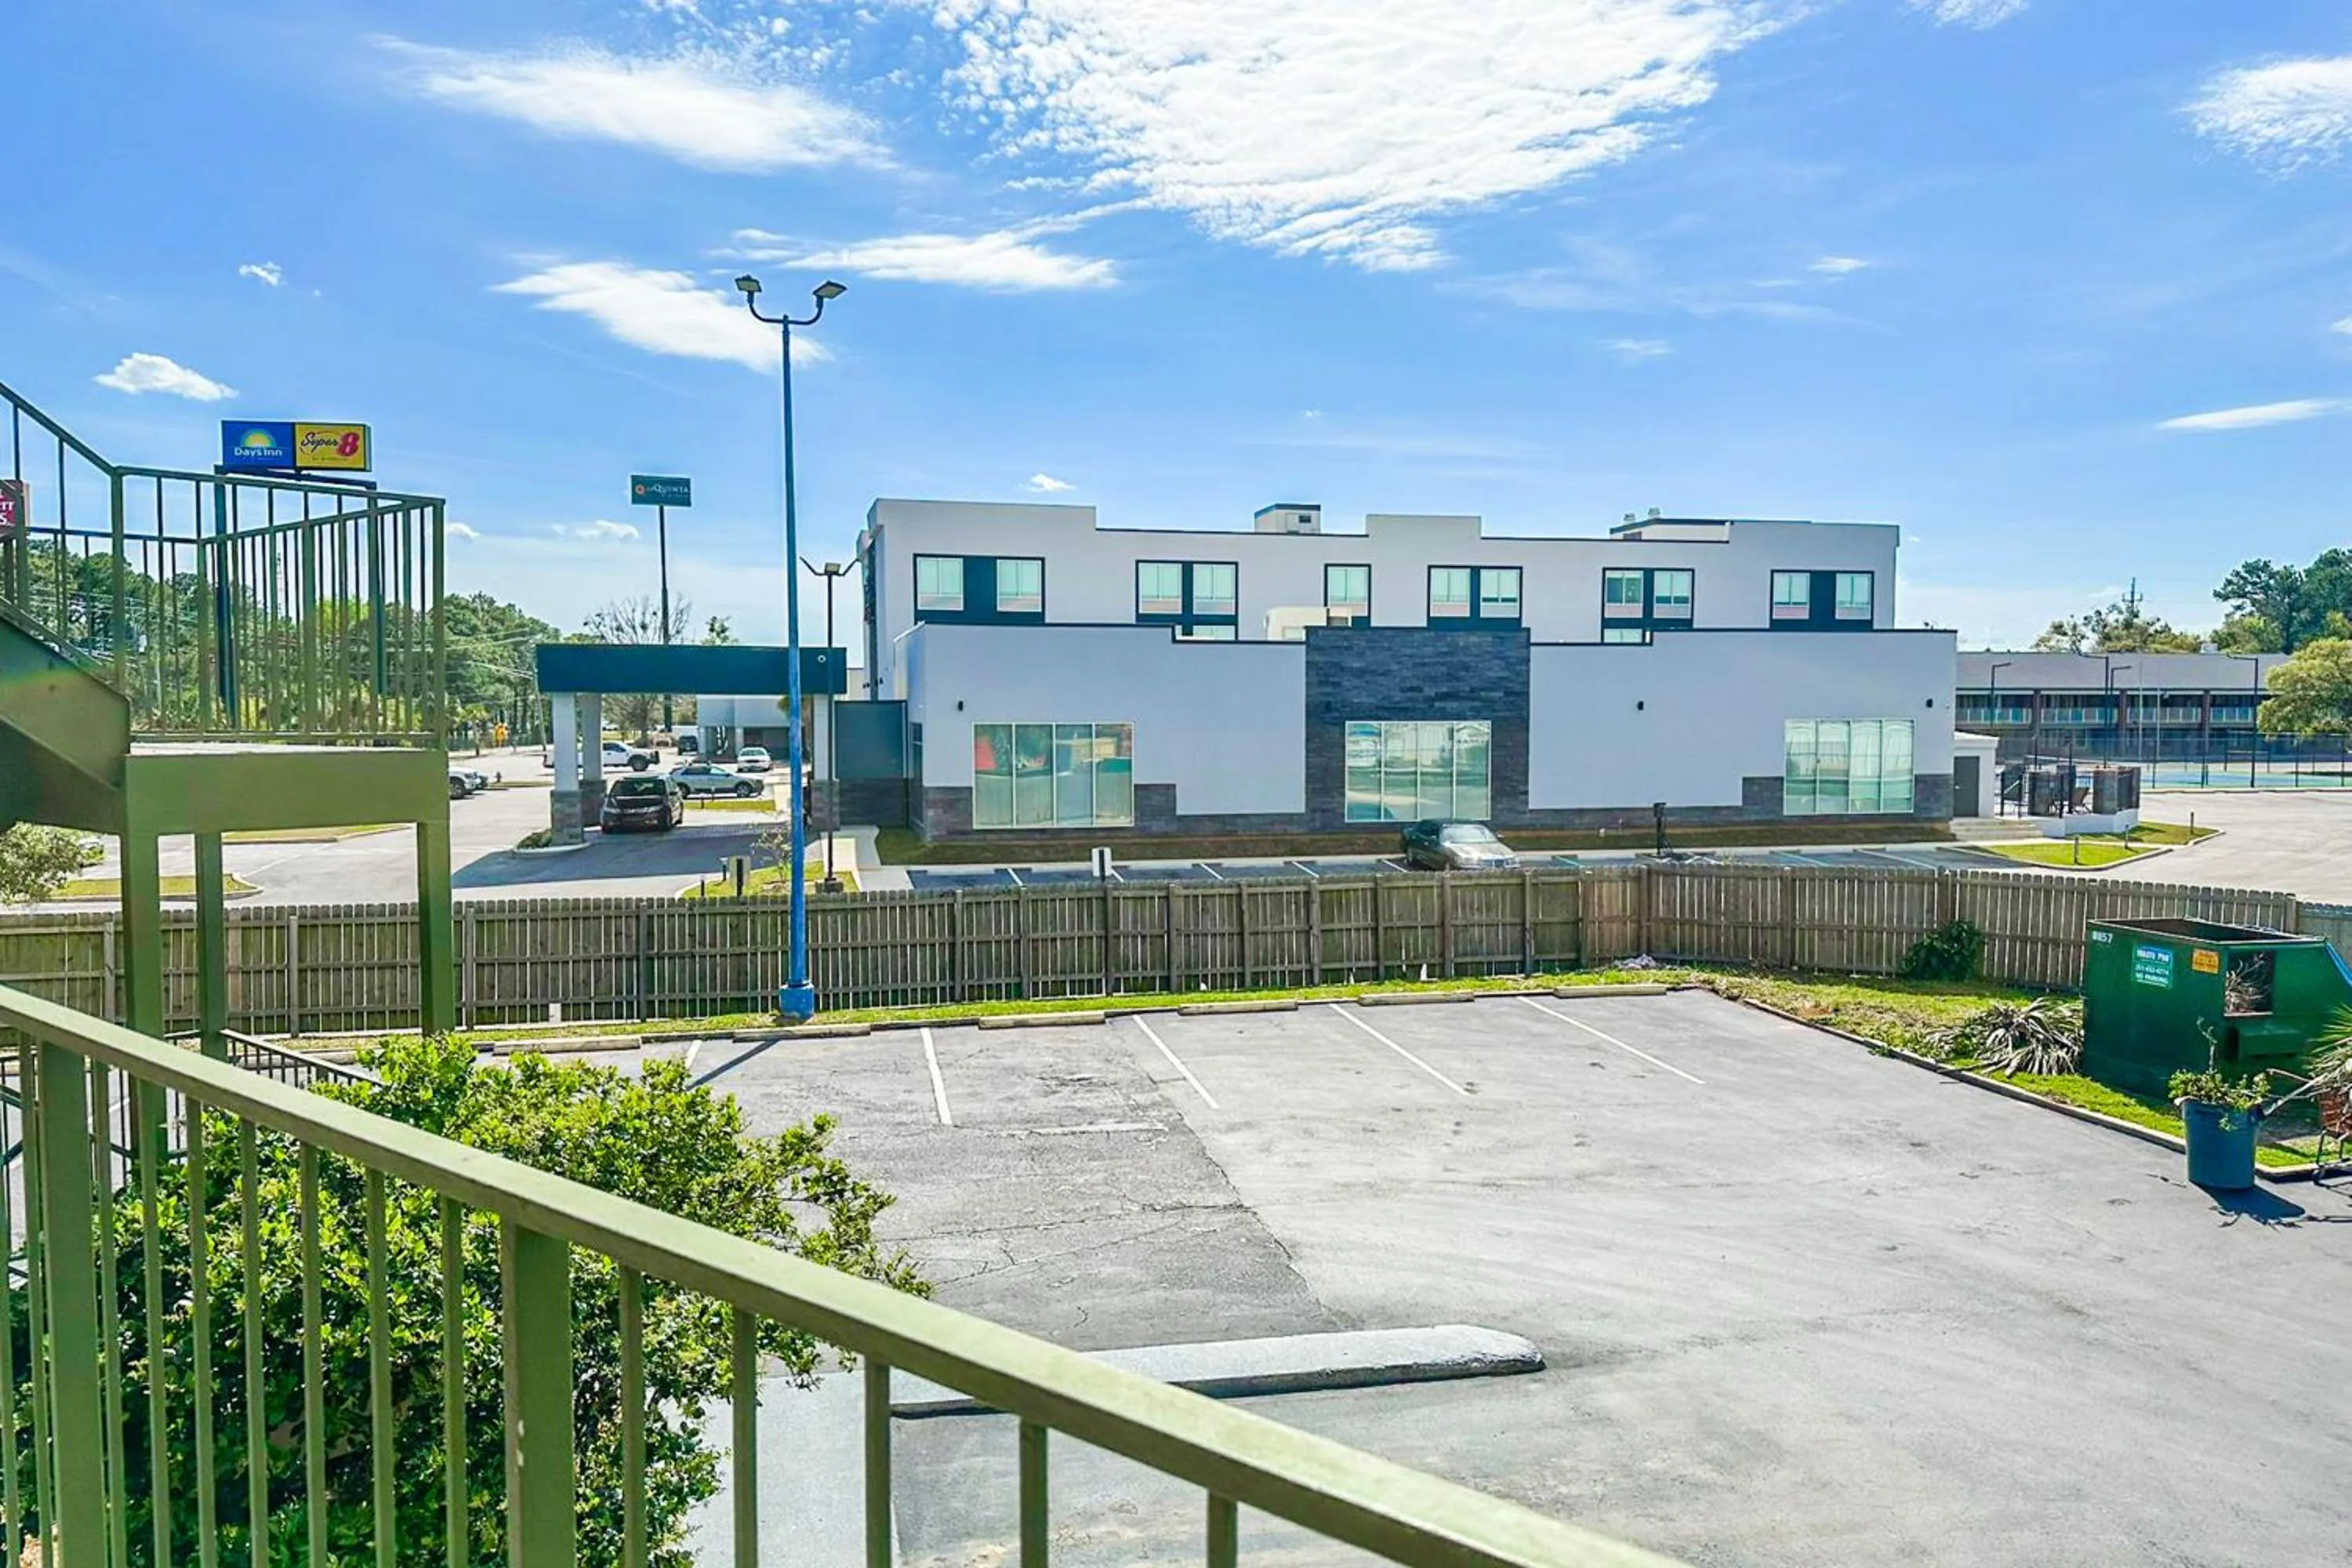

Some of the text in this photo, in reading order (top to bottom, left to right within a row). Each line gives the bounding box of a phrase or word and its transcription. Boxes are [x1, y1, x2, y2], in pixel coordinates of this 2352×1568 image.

[234, 447, 283, 458] Days Inn
[300, 432, 361, 456] Super 8
